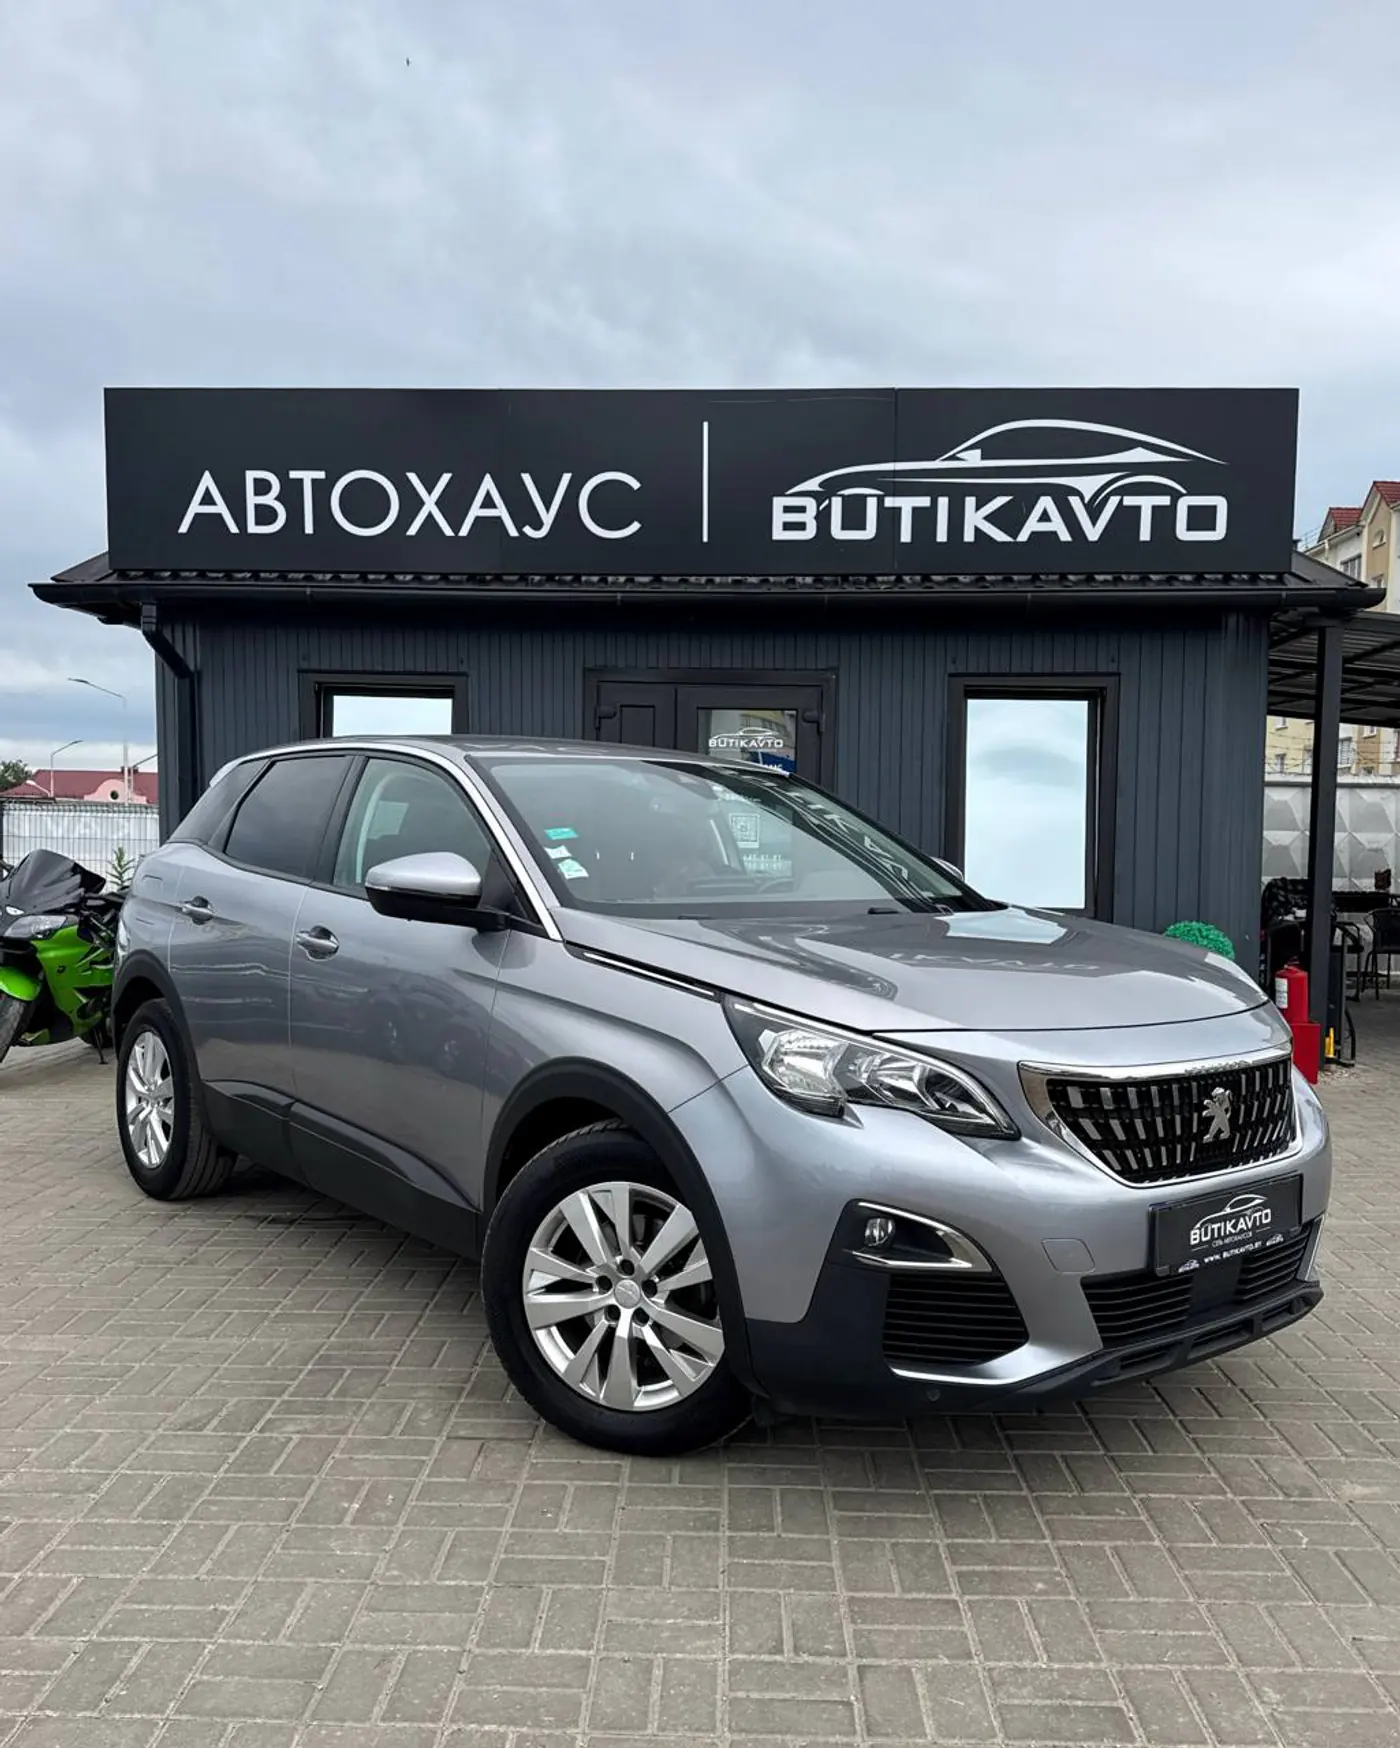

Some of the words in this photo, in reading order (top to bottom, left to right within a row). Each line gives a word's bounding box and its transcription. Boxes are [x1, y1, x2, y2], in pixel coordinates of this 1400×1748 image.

[178, 469, 641, 539] АВТОХАУС
[771, 495, 1228, 542] BUTIKAVTO
[708, 738, 784, 748] BUTIKAVTO
[1190, 1208, 1272, 1245] BUTIKAVTO
